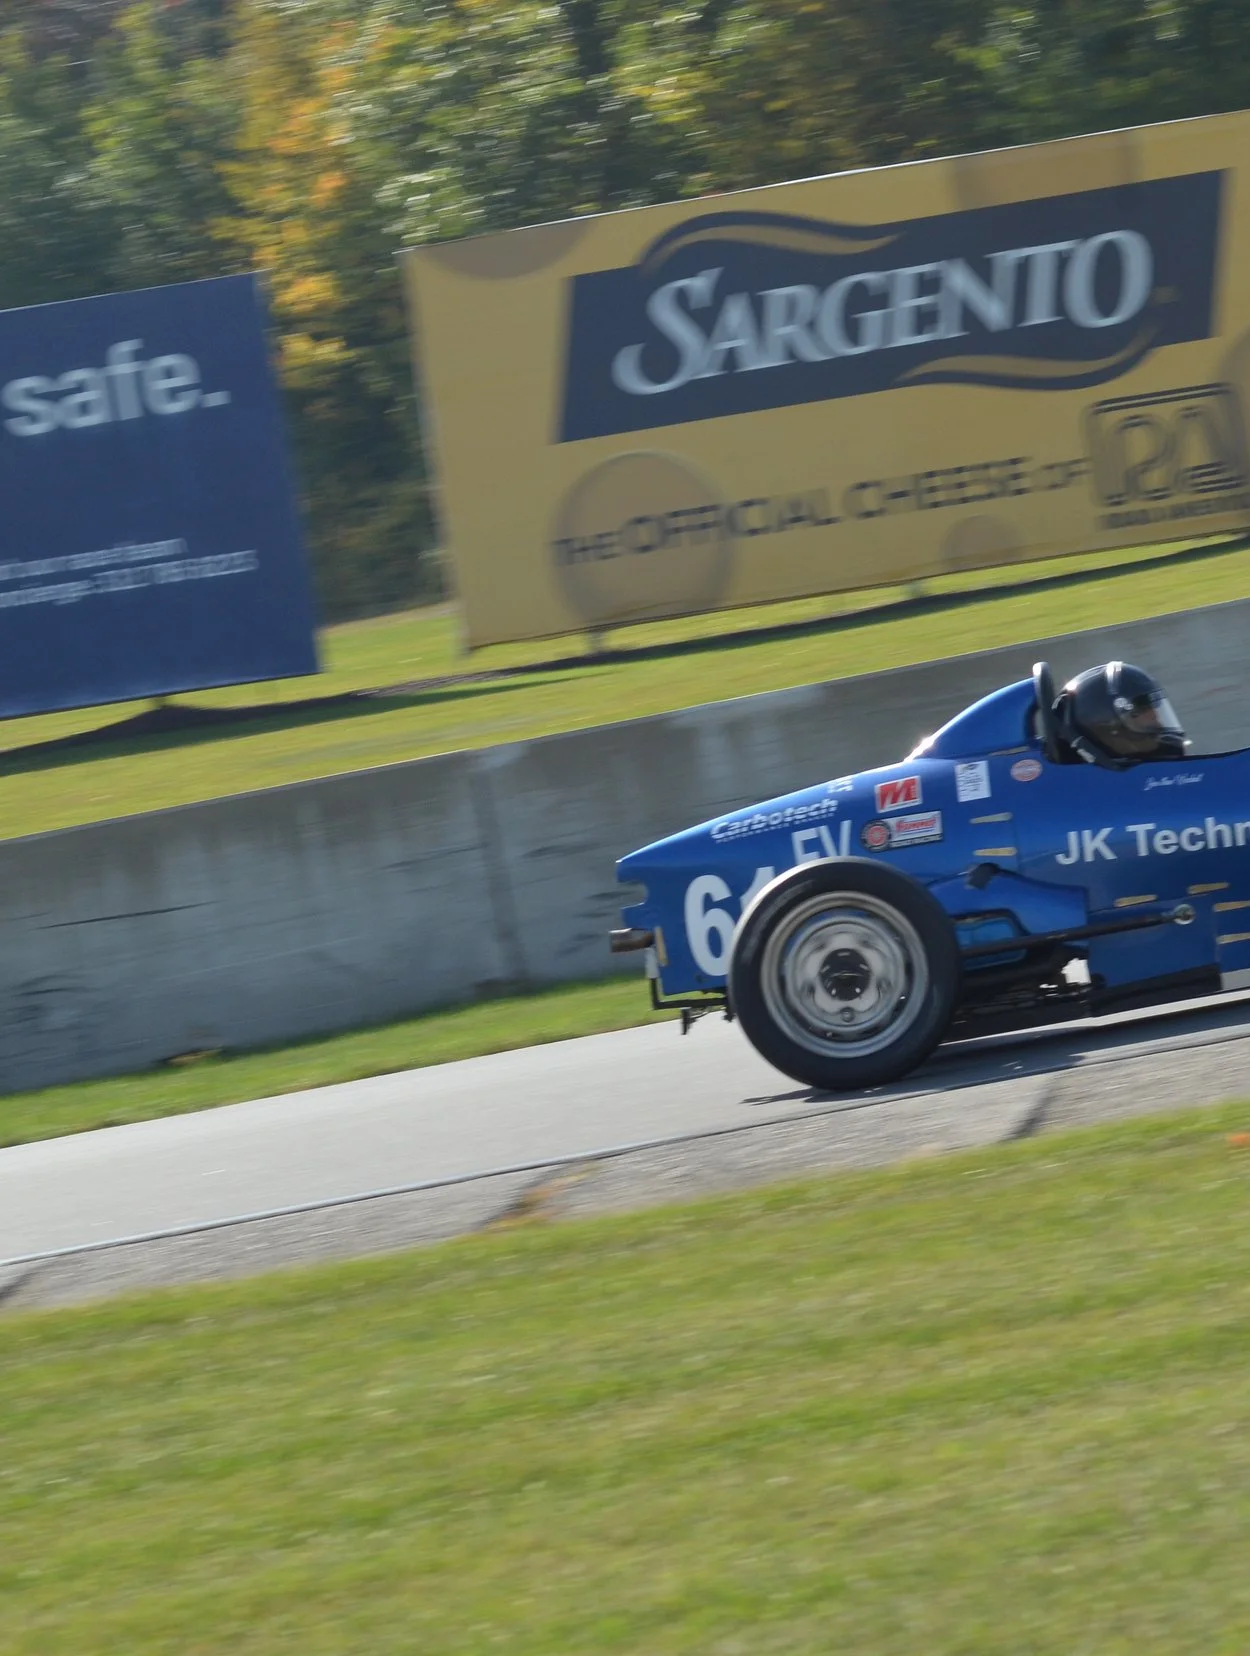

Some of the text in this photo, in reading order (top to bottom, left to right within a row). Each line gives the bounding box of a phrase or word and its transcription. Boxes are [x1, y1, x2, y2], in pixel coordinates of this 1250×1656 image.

[612, 229, 1154, 396] SARGENTO
[2, 337, 232, 437] safe.
[551, 456, 1093, 567] THE OFFICIAL CHEESE OF
[710, 798, 838, 840] Carbotech
[1055, 826, 1118, 865] JK
